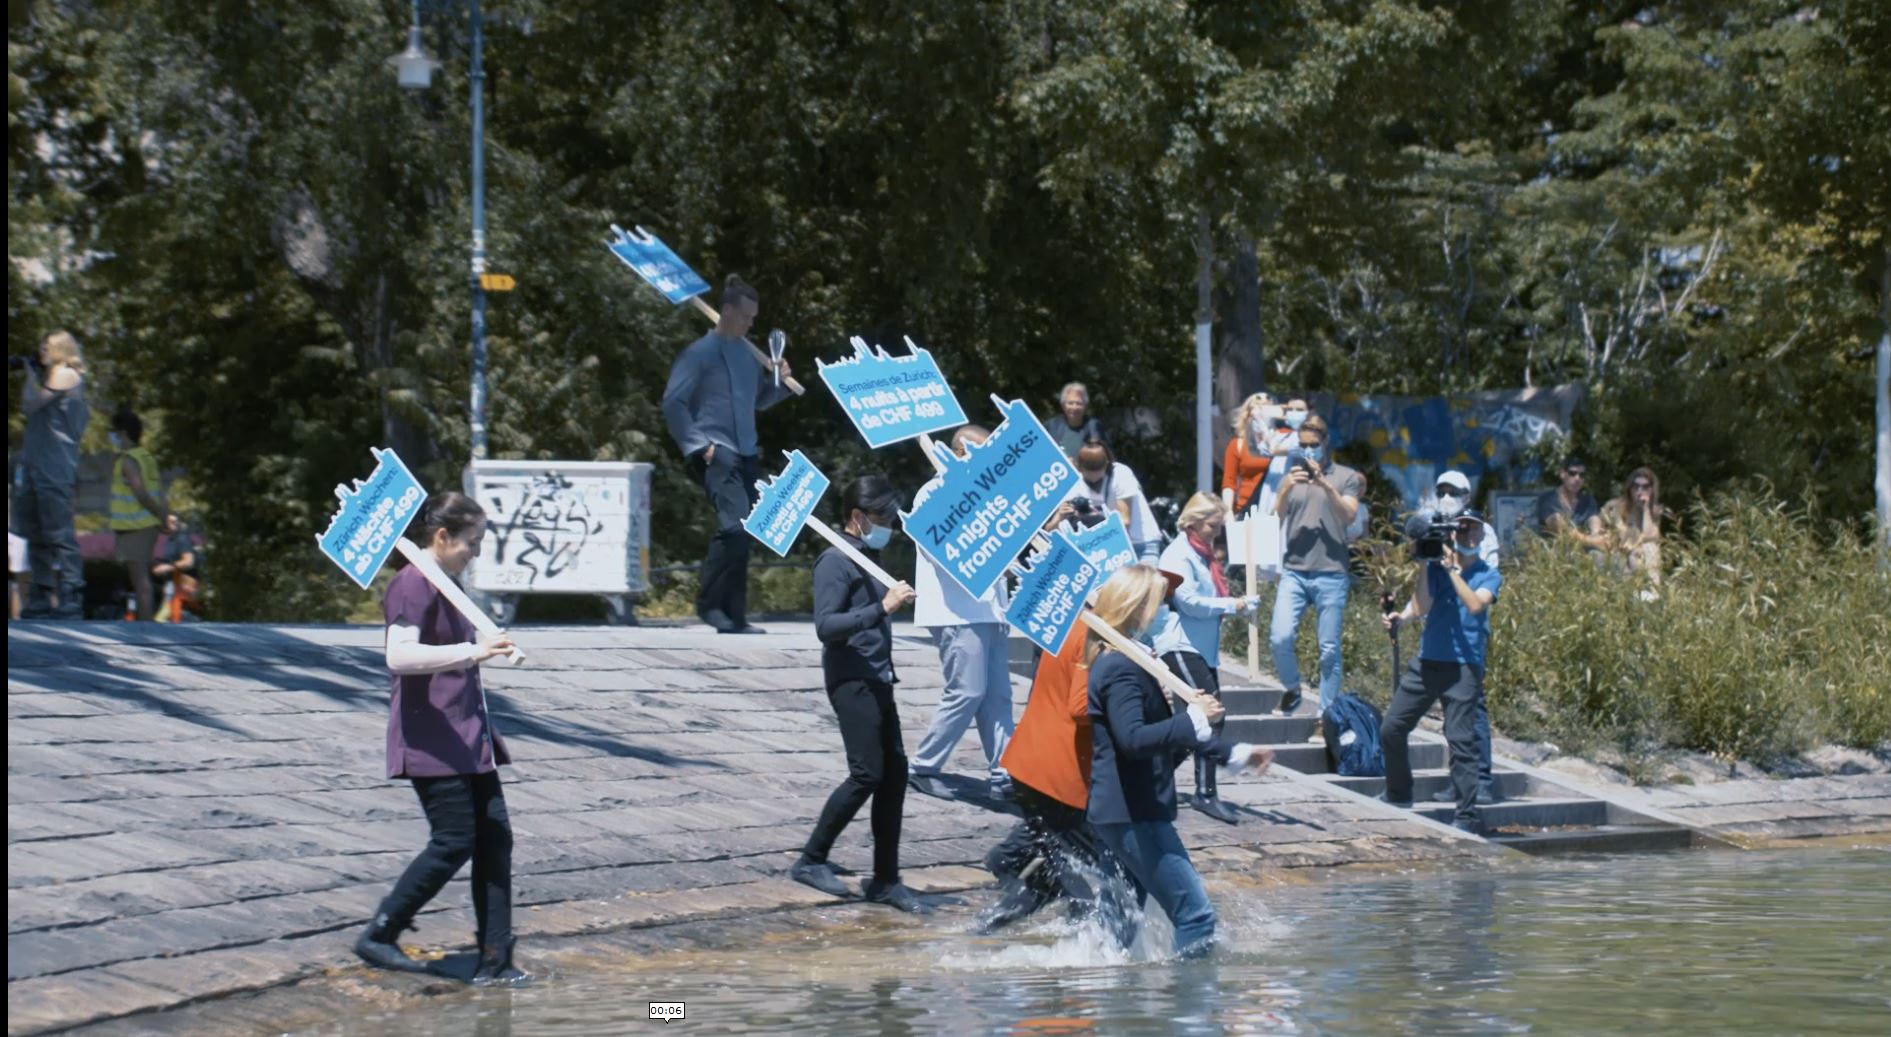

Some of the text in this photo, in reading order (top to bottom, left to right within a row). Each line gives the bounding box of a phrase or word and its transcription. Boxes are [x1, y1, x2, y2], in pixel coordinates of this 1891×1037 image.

[838, 378, 889, 394] Semaines
[889, 374, 902, 384] de
[850, 396, 862, 410] 4
[861, 390, 895, 409] nuits
[907, 381, 946, 405] partir
[861, 400, 945, 430] de CHF 499
[360, 467, 399, 514] Wochen:
[778, 464, 808, 499] Weeks:
[926, 429, 1039, 547] Zurich Weeks:
[343, 497, 394, 563] 4 Nächte
[355, 486, 419, 576] ab CHF 499
[781, 508, 798, 533] CHF
[797, 489, 814, 511] 499
[944, 494, 1009, 561] 4 nights
[958, 461, 1069, 579] from CHF 499
[765, 529, 773, 539] 4
[1037, 546, 1069, 590] Wochen:
[1104, 549, 1132, 573] 499
[1027, 573, 1070, 634] 4 Nächte
[1041, 563, 1094, 645] ab CHF 499
